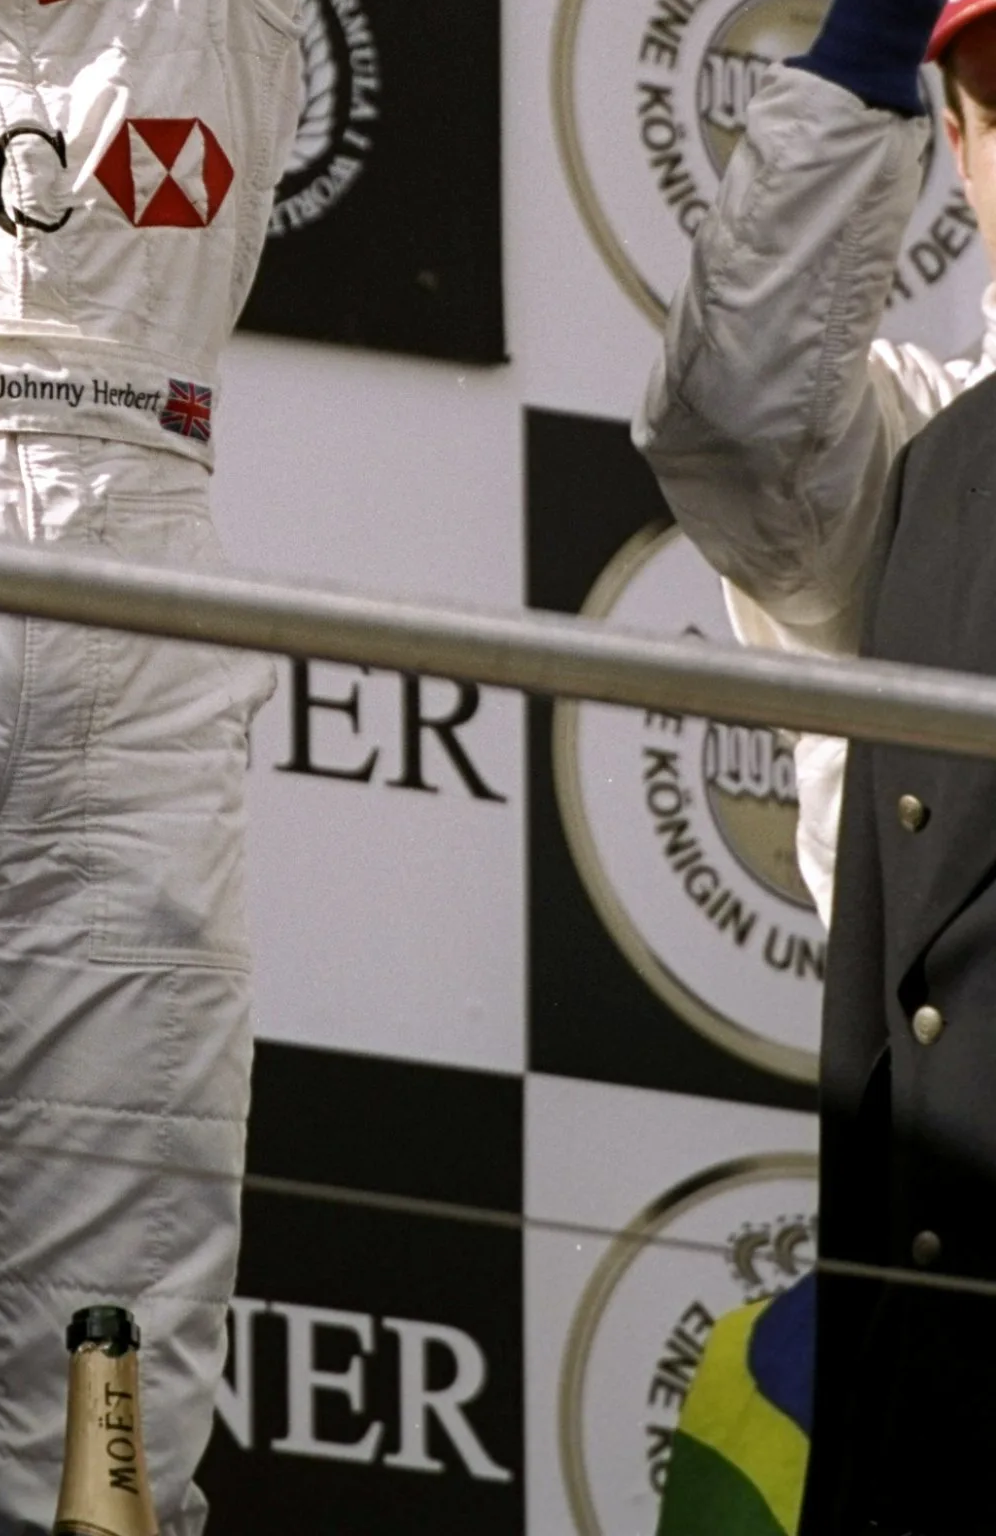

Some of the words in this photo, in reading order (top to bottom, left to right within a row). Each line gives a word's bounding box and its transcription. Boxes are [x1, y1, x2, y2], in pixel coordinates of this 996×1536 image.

[636, 80, 710, 239] KÖNIG
[93, 378, 161, 412] Herbert
[641, 744, 758, 948] KÖNIGIN
[97, 1382, 139, 1496] MOËT
